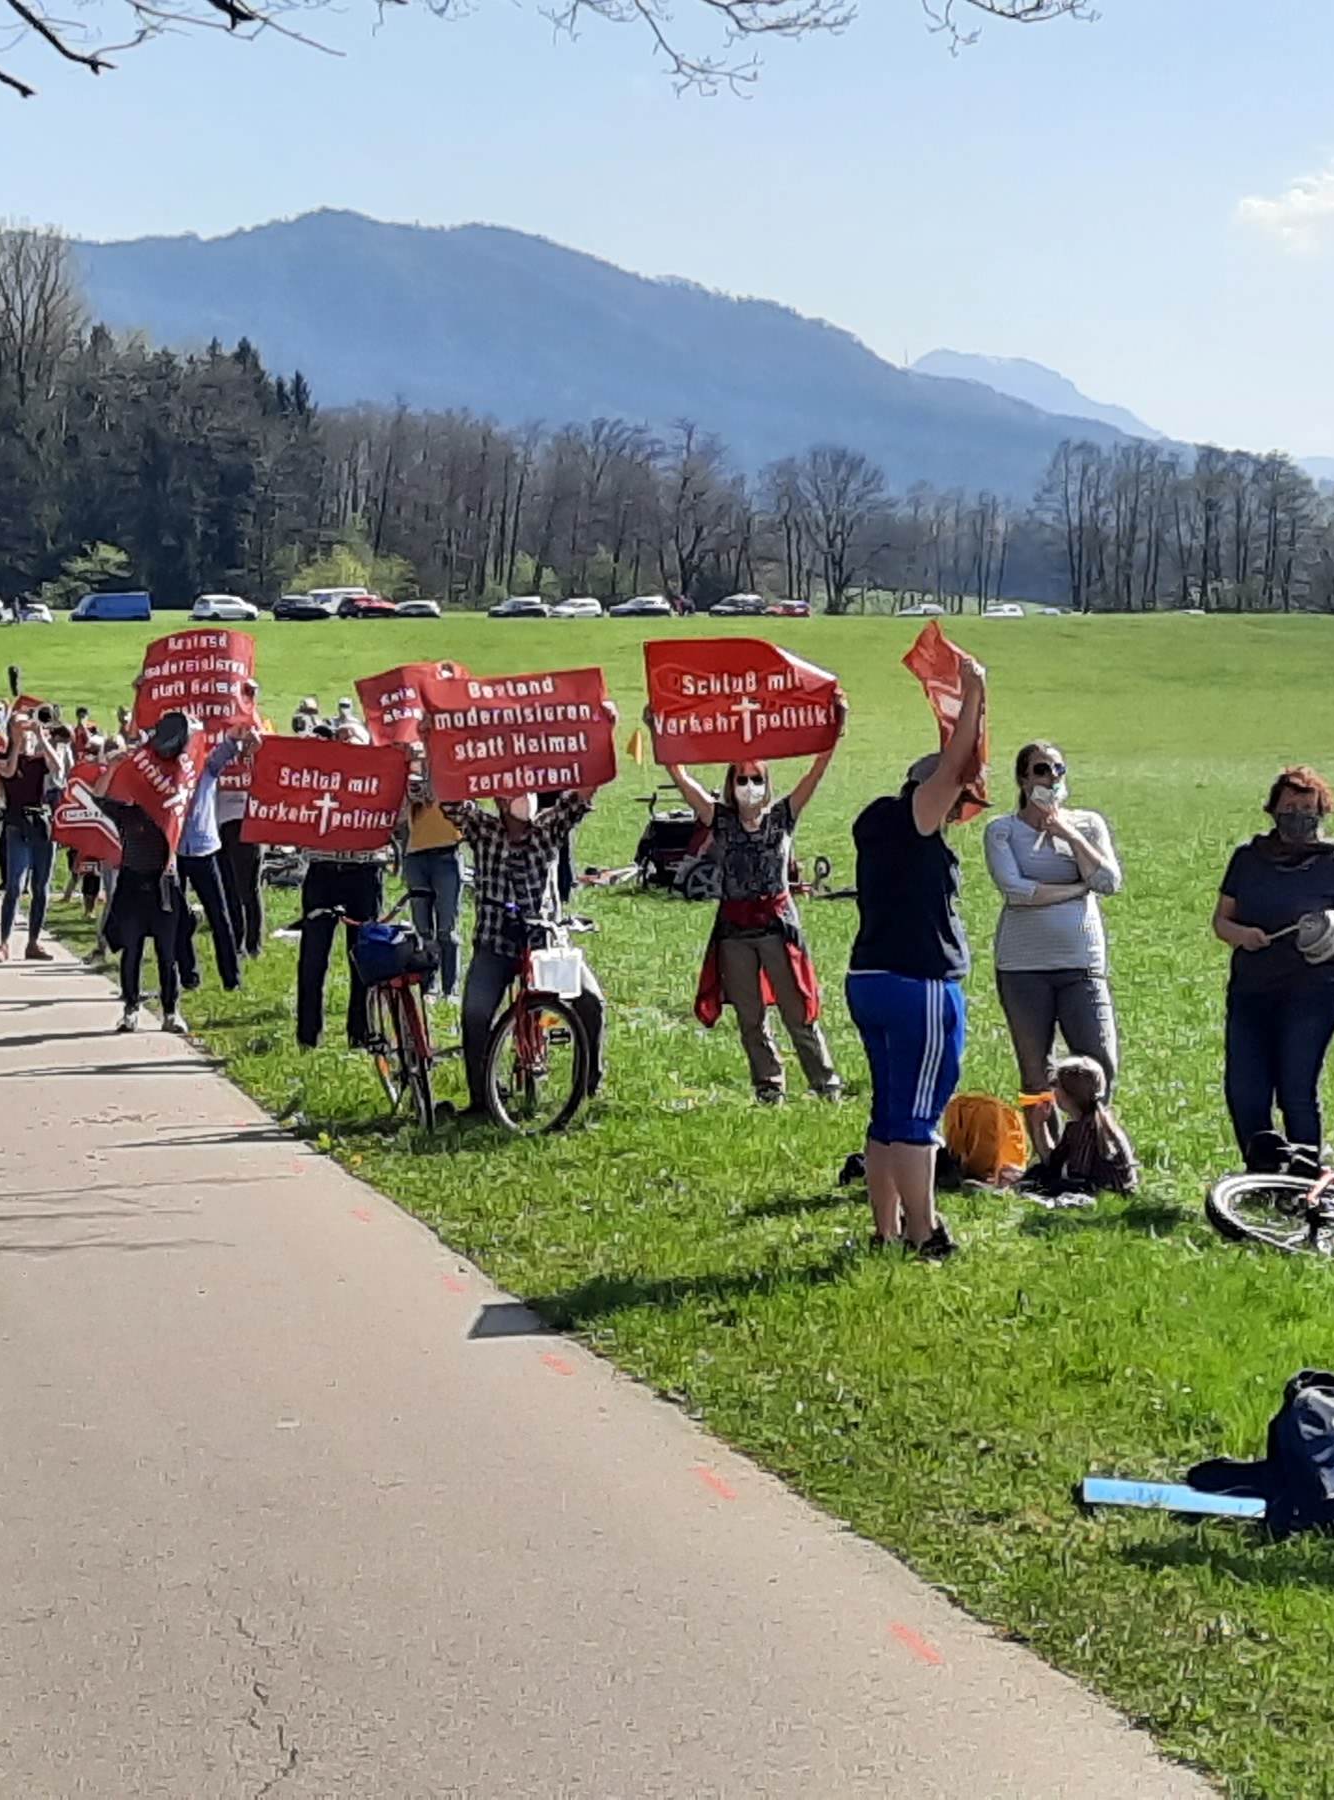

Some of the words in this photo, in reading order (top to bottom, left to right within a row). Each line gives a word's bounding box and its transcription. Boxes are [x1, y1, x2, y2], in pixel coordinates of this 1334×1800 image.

[468, 676, 554, 698] Bestand
[681, 671, 757, 695] Schluß
[768, 667, 801, 691] mit
[654, 711, 739, 735] Verkehr
[454, 735, 504, 760] statt
[512, 731, 587, 755] Heimat
[279, 766, 341, 790] Schluß
[348, 777, 379, 795] mit
[468, 762, 581, 792] zerstören!
[249, 796, 318, 823] Verkehr
